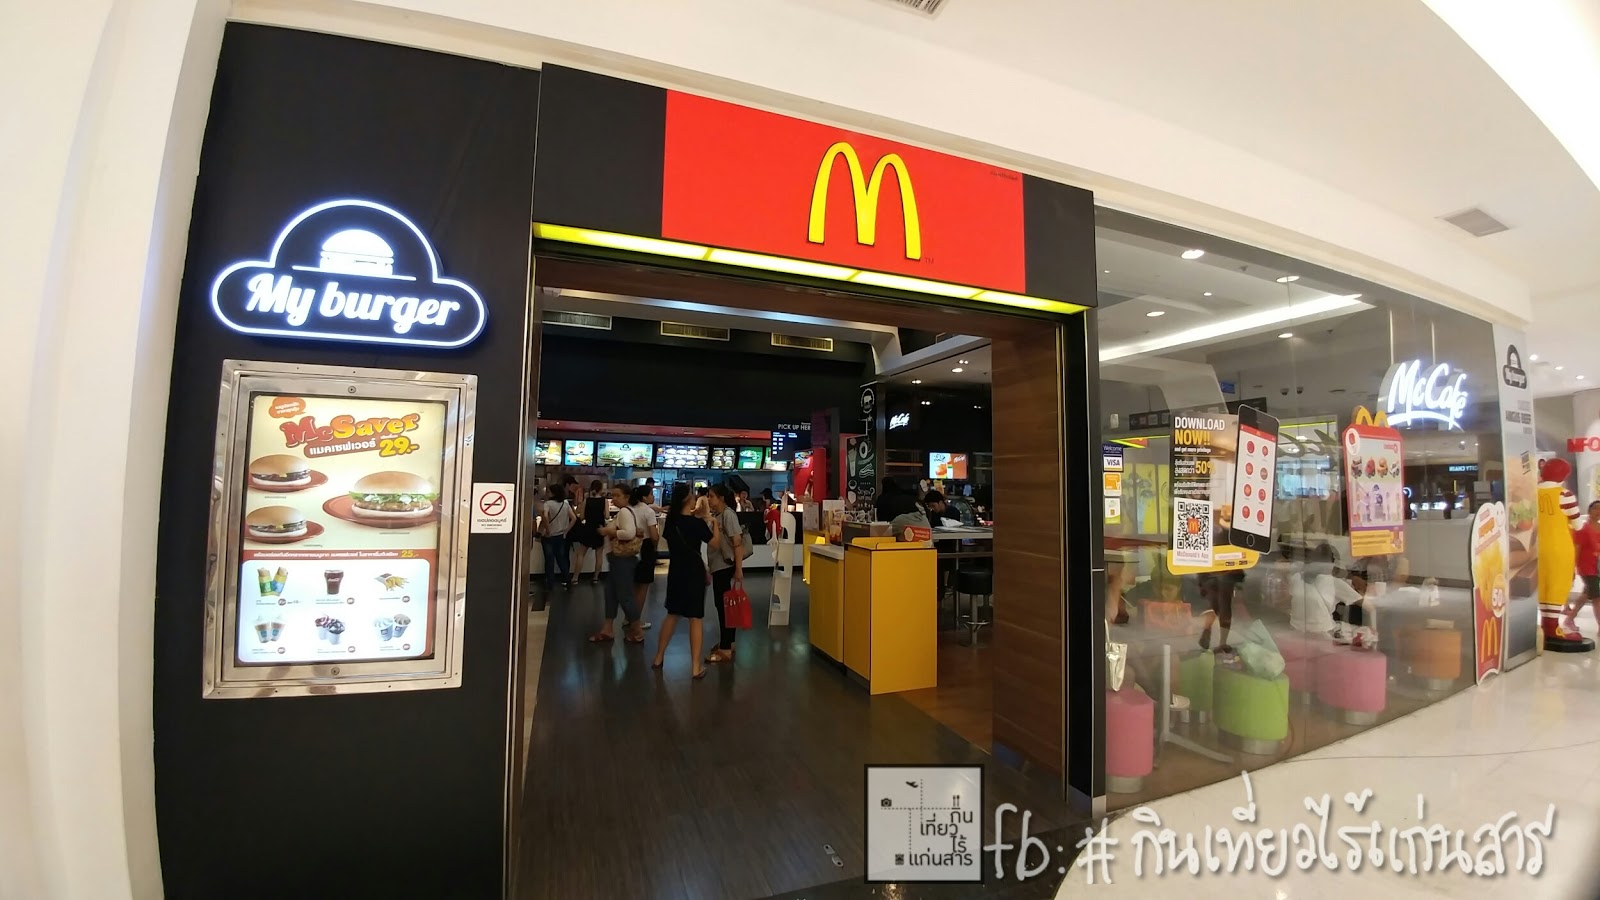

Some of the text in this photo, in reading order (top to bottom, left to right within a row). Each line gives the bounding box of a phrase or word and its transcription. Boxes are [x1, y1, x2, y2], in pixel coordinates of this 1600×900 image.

[247, 272, 461, 335] My burger
[279, 413, 420, 448] McSaver
[1174, 416, 1225, 431] DOWNLOAD
[1174, 429, 1211, 446] NOW!!
[1106, 459, 1120, 467] VISA
